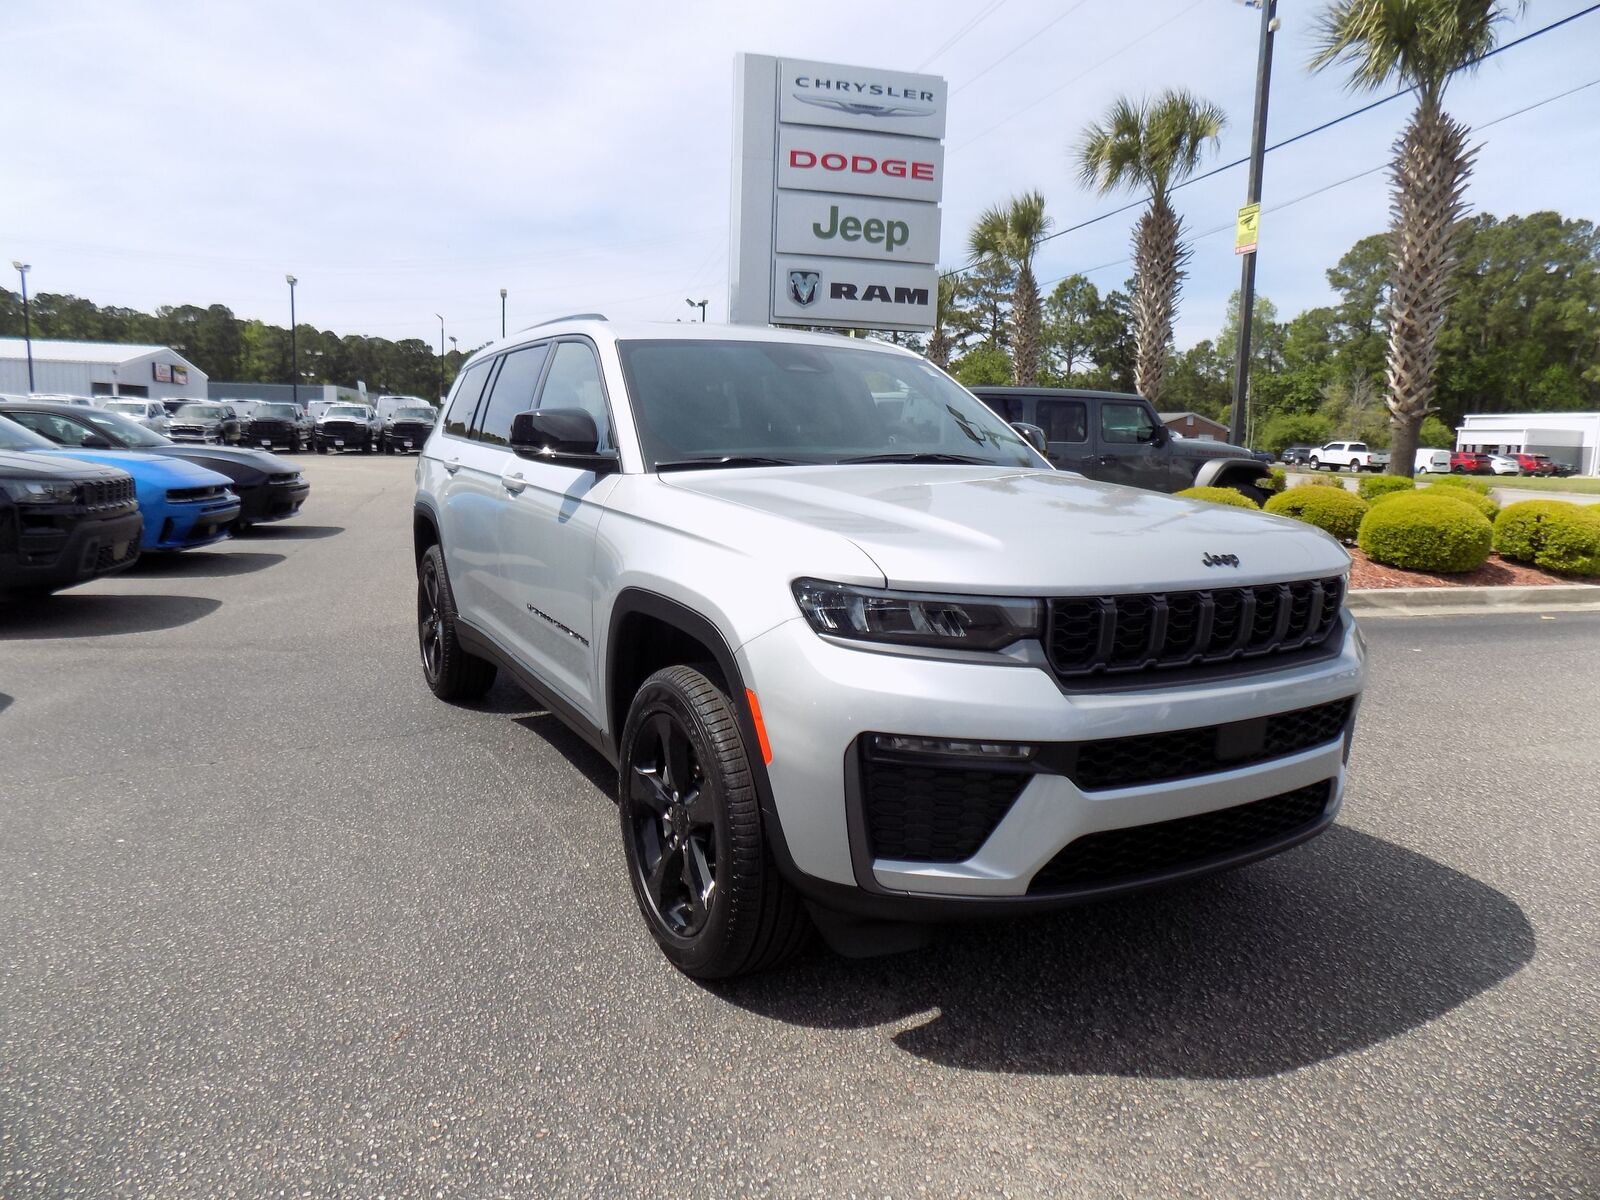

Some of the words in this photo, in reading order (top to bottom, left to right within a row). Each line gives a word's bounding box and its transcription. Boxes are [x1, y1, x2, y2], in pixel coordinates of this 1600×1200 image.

[795, 76, 934, 101] CHRYSLER
[790, 150, 935, 181] DODGE
[812, 205, 909, 252] Jeep
[830, 282, 929, 305] RAM
[1202, 551, 1240, 568] Jeep
